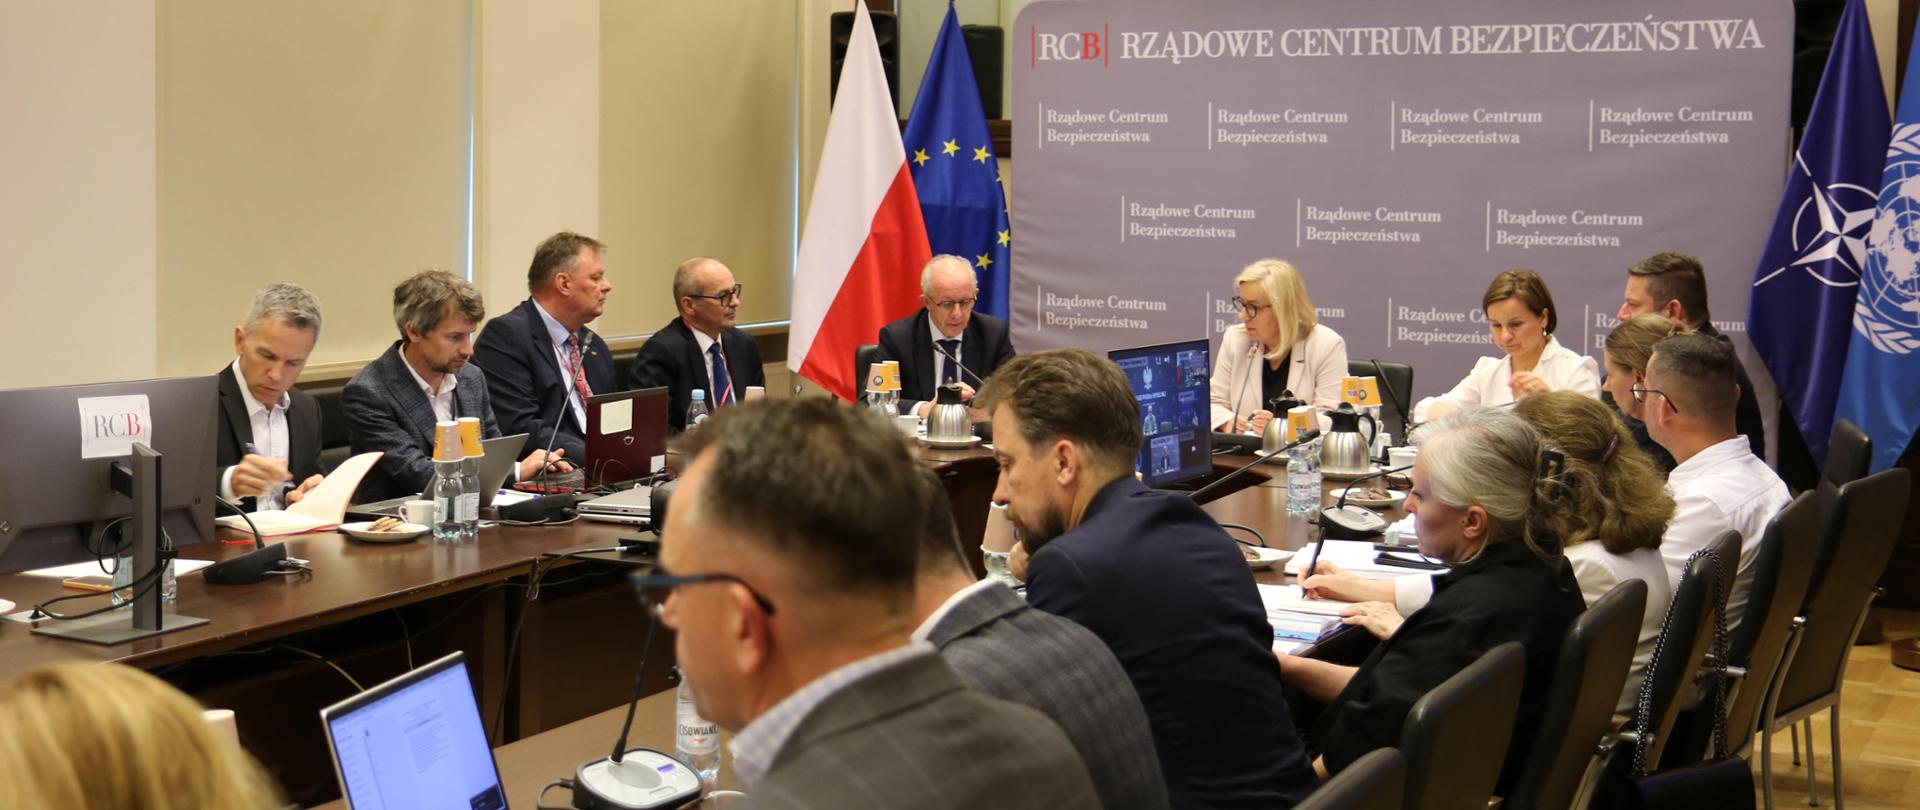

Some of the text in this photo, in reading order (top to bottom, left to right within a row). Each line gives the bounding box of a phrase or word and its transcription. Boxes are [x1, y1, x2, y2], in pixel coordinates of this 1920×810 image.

[1038, 14, 1765, 64] RCB RZĄDOWE CENTRUM BEZPIECZEŃSTWA
[1048, 109, 1168, 125] Rządowe Centrum
[1218, 109, 1347, 126] Rządowe Centrum
[1402, 109, 1542, 126] Rządowe Centrum
[1601, 107, 1753, 125] Rządowe Centrum
[1048, 129, 1149, 145] Bezpieczeństwa
[1218, 129, 1327, 146] Bezpieczeństwa
[1401, 129, 1520, 147] Bezpieczeństwa
[1600, 128, 1728, 147] Bezpieczeństwa
[1131, 203, 1255, 219] Rządowe Centrum
[1307, 206, 1441, 223] Rządowe Centrum
[1498, 209, 1642, 227] Rządowe Centrum
[1130, 222, 1236, 240] Bezpieczeństwa
[1307, 226, 1420, 244] Bezpieczeństwa
[1496, 230, 1620, 248] Bezpieczeństwa
[1046, 293, 1166, 310] Rządowe Centrum
[1046, 312, 1148, 329] Bezpieczeństwa
[1399, 306, 1465, 324] Rządowe
[1398, 326, 1492, 345] Bezpieczeńst
[94, 412, 141, 438] RCB
